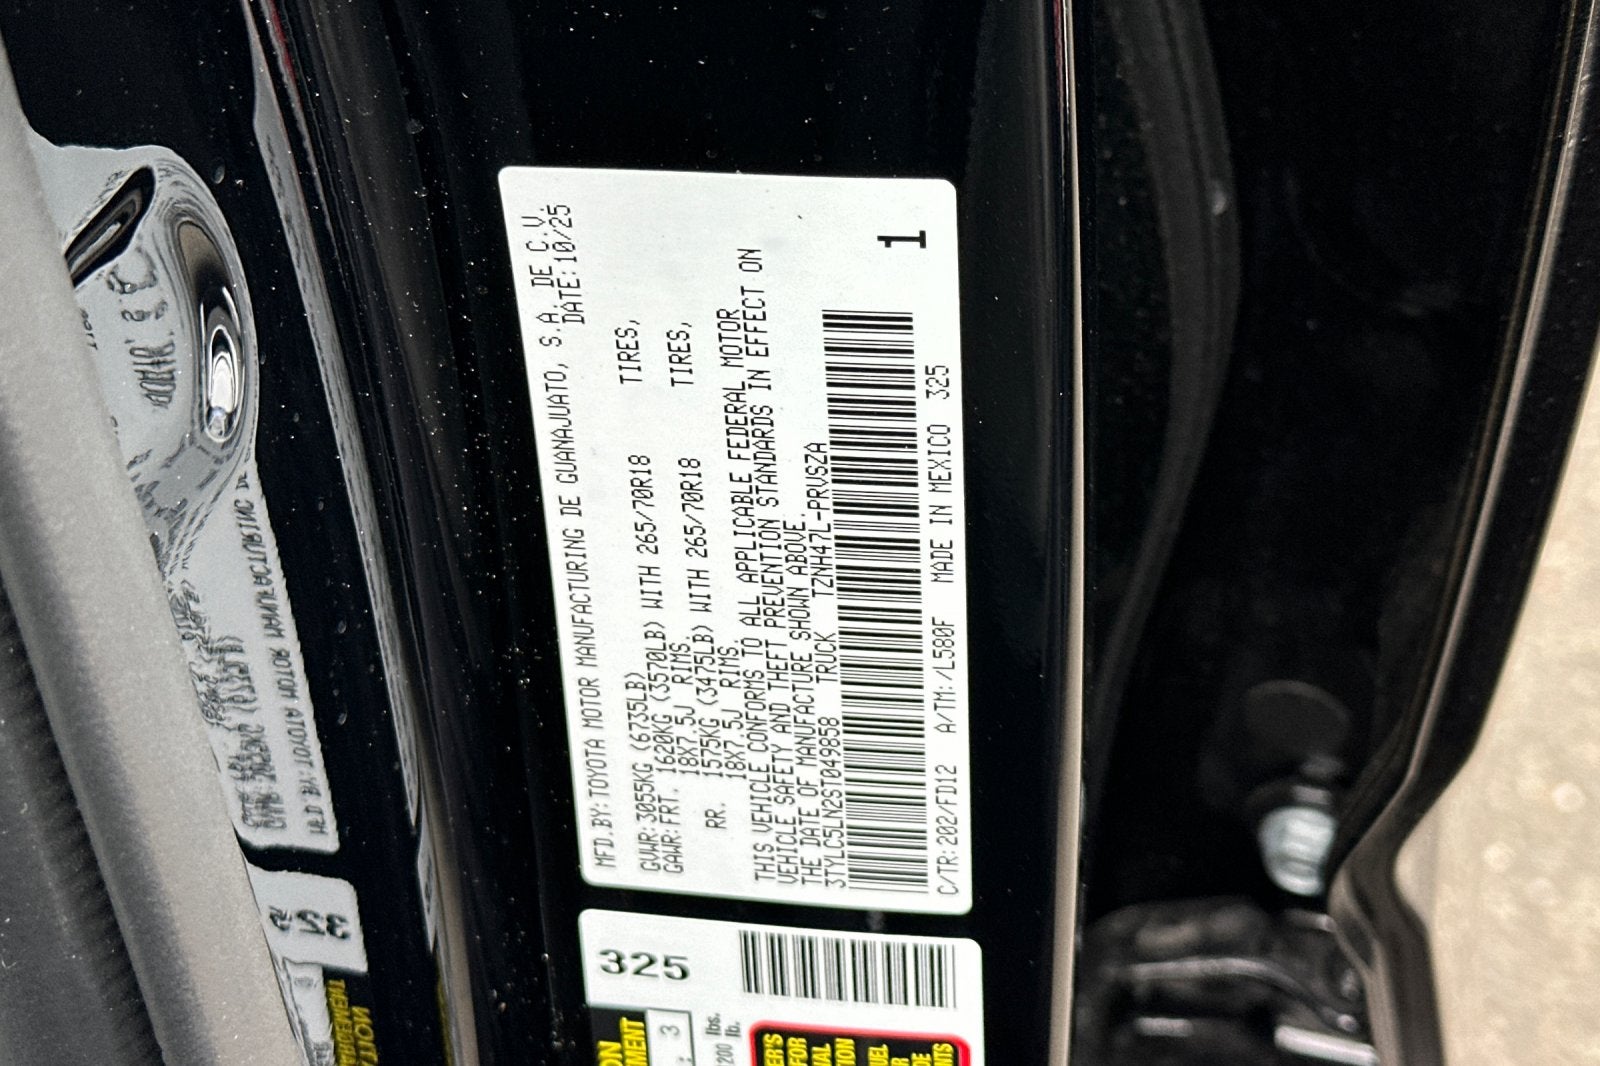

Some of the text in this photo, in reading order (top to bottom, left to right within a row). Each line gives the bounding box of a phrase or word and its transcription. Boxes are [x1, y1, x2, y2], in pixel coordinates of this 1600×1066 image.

[521, 208, 549, 252] C.V.
[877, 229, 926, 250] 1
[529, 264, 554, 288] DE
[547, 204, 585, 325] DATE:10/25
[536, 304, 562, 348] S.A.
[615, 319, 643, 385] TIRES,
[925, 365, 949, 400] 325
[544, 363, 578, 484] GUANAJUATO,
[927, 424, 952, 494] MEXICO
[558, 494, 582, 518] DE
[628, 454, 658, 555] 265/70R18
[929, 504, 952, 526] IN
[638, 565, 663, 610] WITH
[666, 322, 726, 830] RR. 1575KG (3475LB) WITH 265/70R18 TIRES,
[737, 248, 802, 885] VEHICLE SAFETY AND THEFT PREVENTION STANDARDS IN EFFECT ON
[930, 538, 953, 584] MADE
[562, 528, 597, 668] MANUFACTURING
[716, 308, 779, 883] THIS VEHICLE CONFORMS TO ALL APPLICABLE FEDERAL MOTOR
[643, 621, 670, 702] (3570LB)
[804, 442, 849, 889] 3TYLC5LN2ST049858 TRUCK TZNH47L-PRVSZA
[578, 676, 603, 730] MOTOR
[624, 672, 651, 752] (6735LB)
[669, 636, 700, 776] 18X7.5J RIMS.
[717, 640, 747, 780] 18X7.5J RIMS.
[783, 513, 826, 887] THE DATE OF MANUFACTURE SHOWN ABOVE.
[651, 713, 679, 774] 1620KG
[935, 764, 958, 896] C/TR:202/FD12
[599, 949, 690, 980] 325
[659, 1025, 680, 1036] 3
[705, 1013, 722, 1036] lbs.
[715, 1022, 742, 1066] 200 lb.
[787, 1037, 808, 1066] FOR
